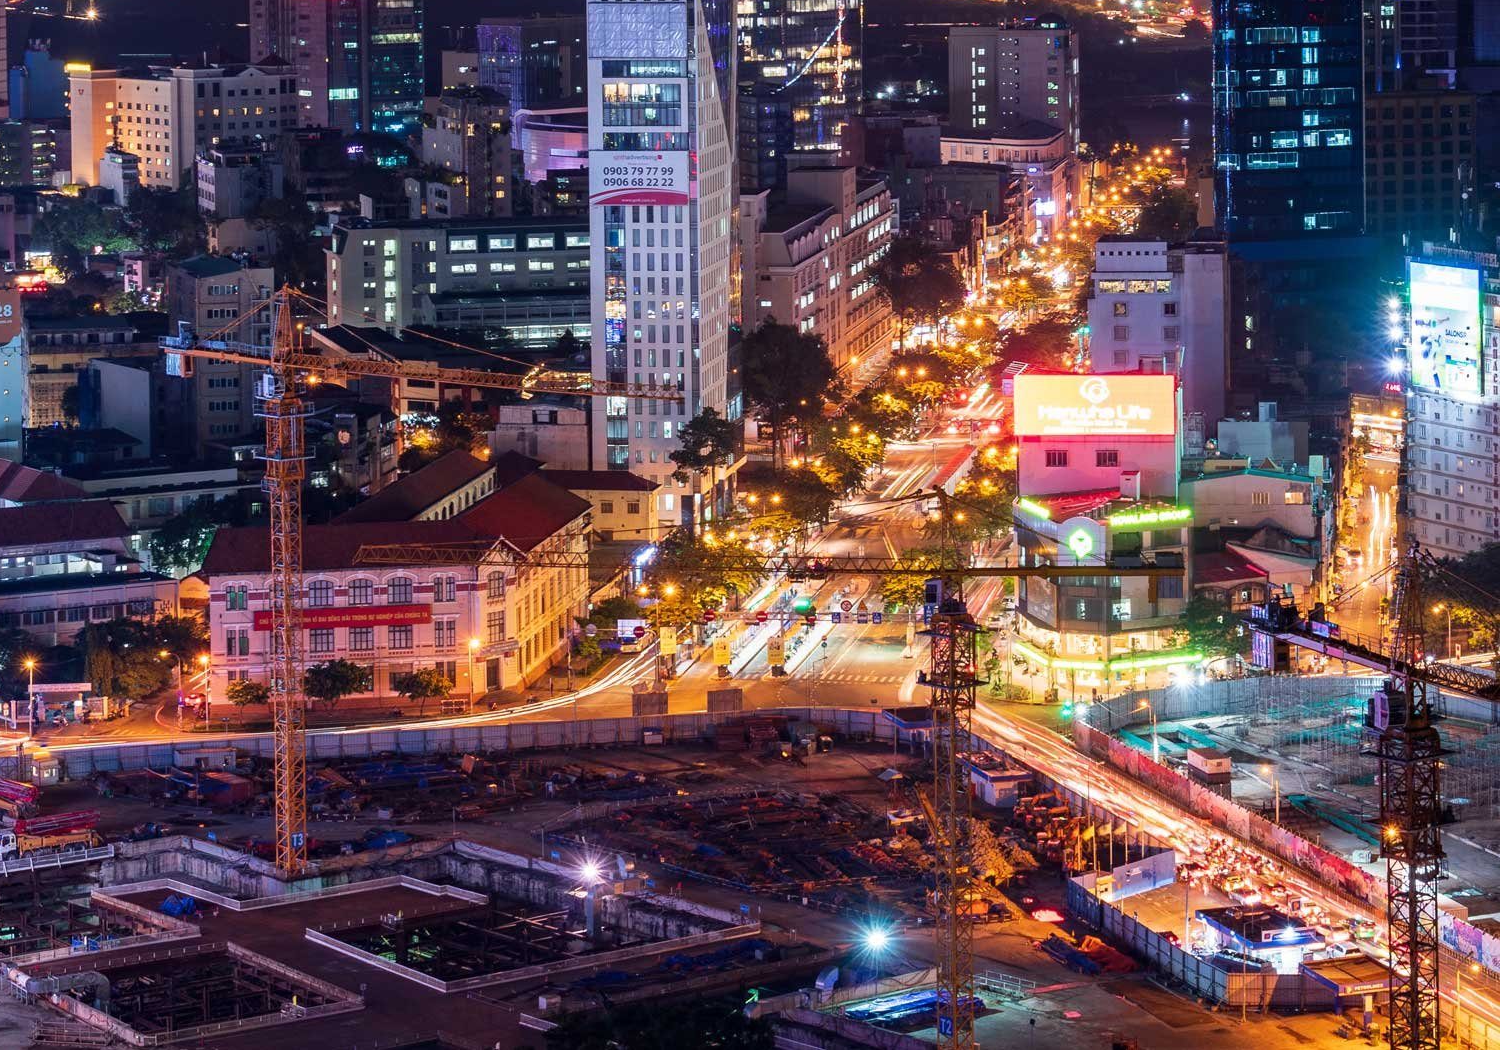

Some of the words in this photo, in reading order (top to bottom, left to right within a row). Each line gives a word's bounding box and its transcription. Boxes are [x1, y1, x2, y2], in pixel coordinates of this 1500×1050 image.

[603, 166, 629, 176] 0903
[631, 166, 644, 176] 79
[646, 166, 659, 176] 77
[661, 166, 674, 176] 99
[603, 177, 629, 187] 0906
[631, 177, 644, 187] 68
[646, 177, 659, 187] 22
[661, 177, 674, 187] 22
[291, 833, 304, 847] T3
[940, 1017, 952, 1035] T2
